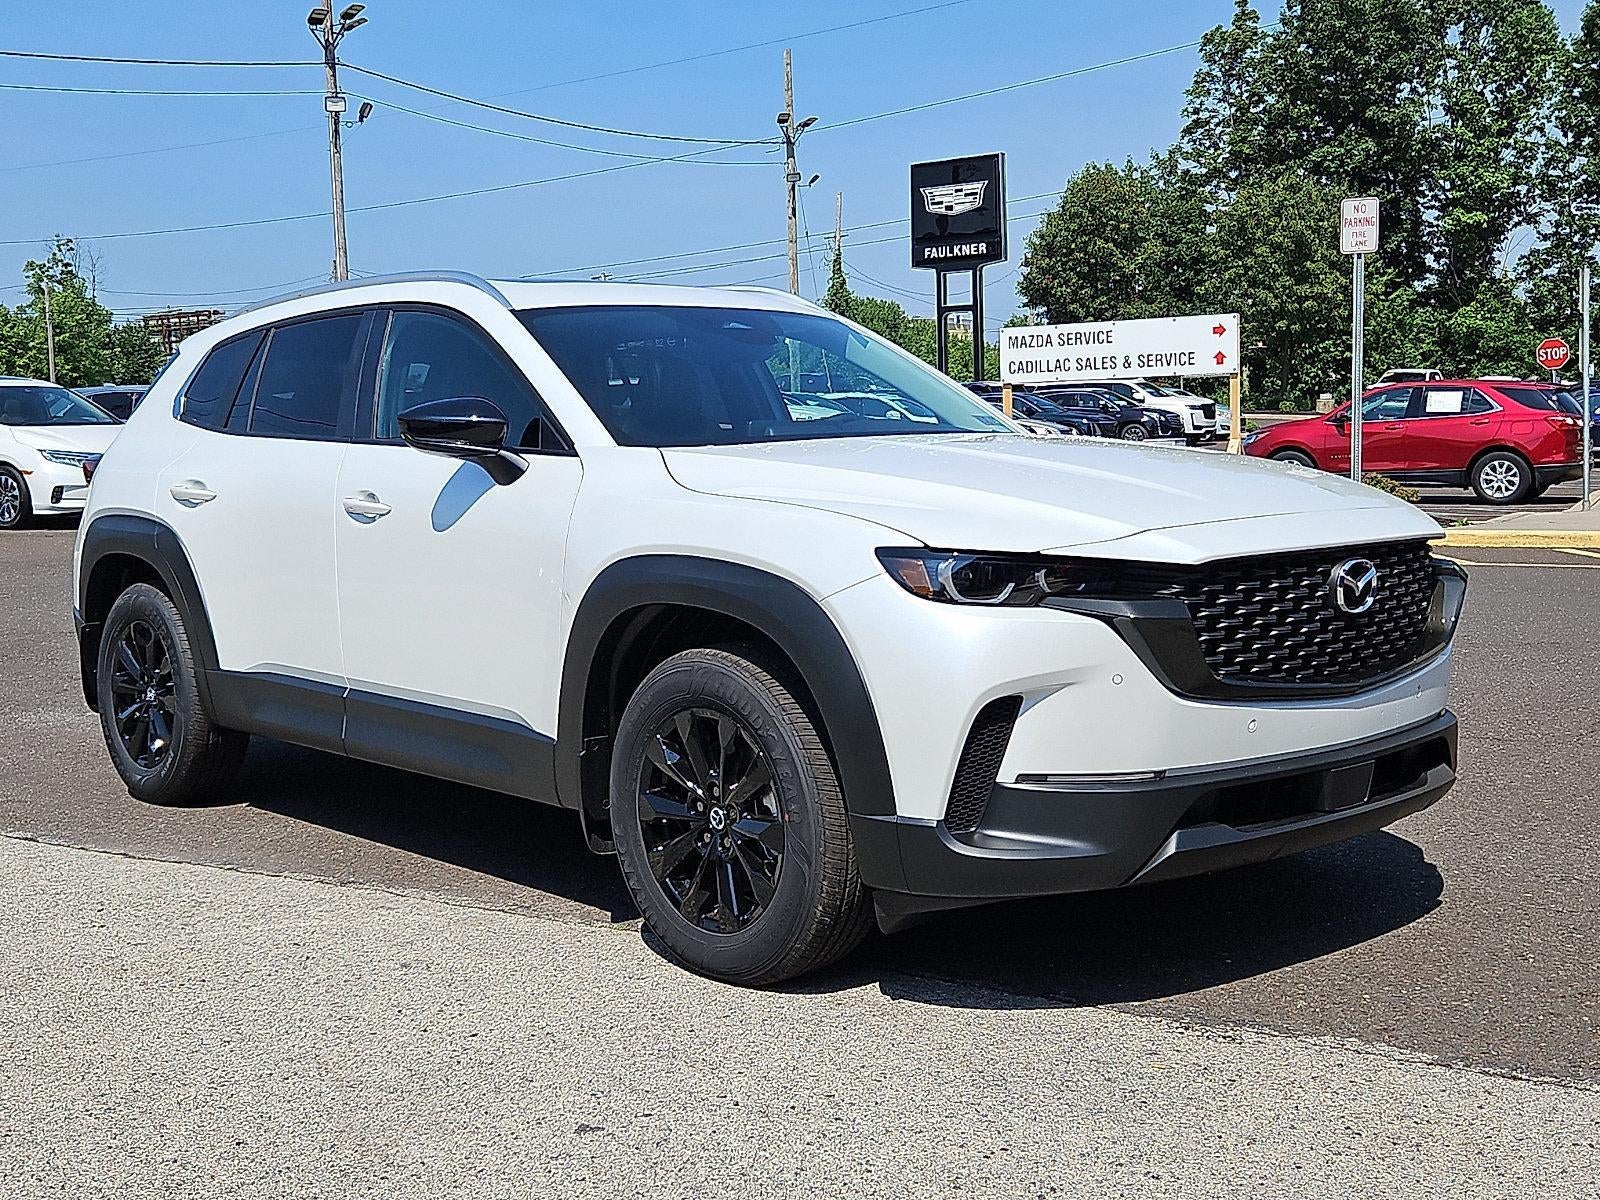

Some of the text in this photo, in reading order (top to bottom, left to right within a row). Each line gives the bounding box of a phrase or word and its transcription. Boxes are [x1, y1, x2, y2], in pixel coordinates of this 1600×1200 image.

[1353, 203, 1367, 214] NO
[1343, 215, 1376, 228] PARKING
[1351, 230, 1367, 239] FIRE
[924, 242, 987, 259] FAULKNER
[1350, 239, 1368, 248] LANE
[1008, 329, 1114, 350] MAZDA SERVICE
[1539, 346, 1568, 361] STOP
[1008, 351, 1196, 375] CADILLAC SALES & SERVICE
